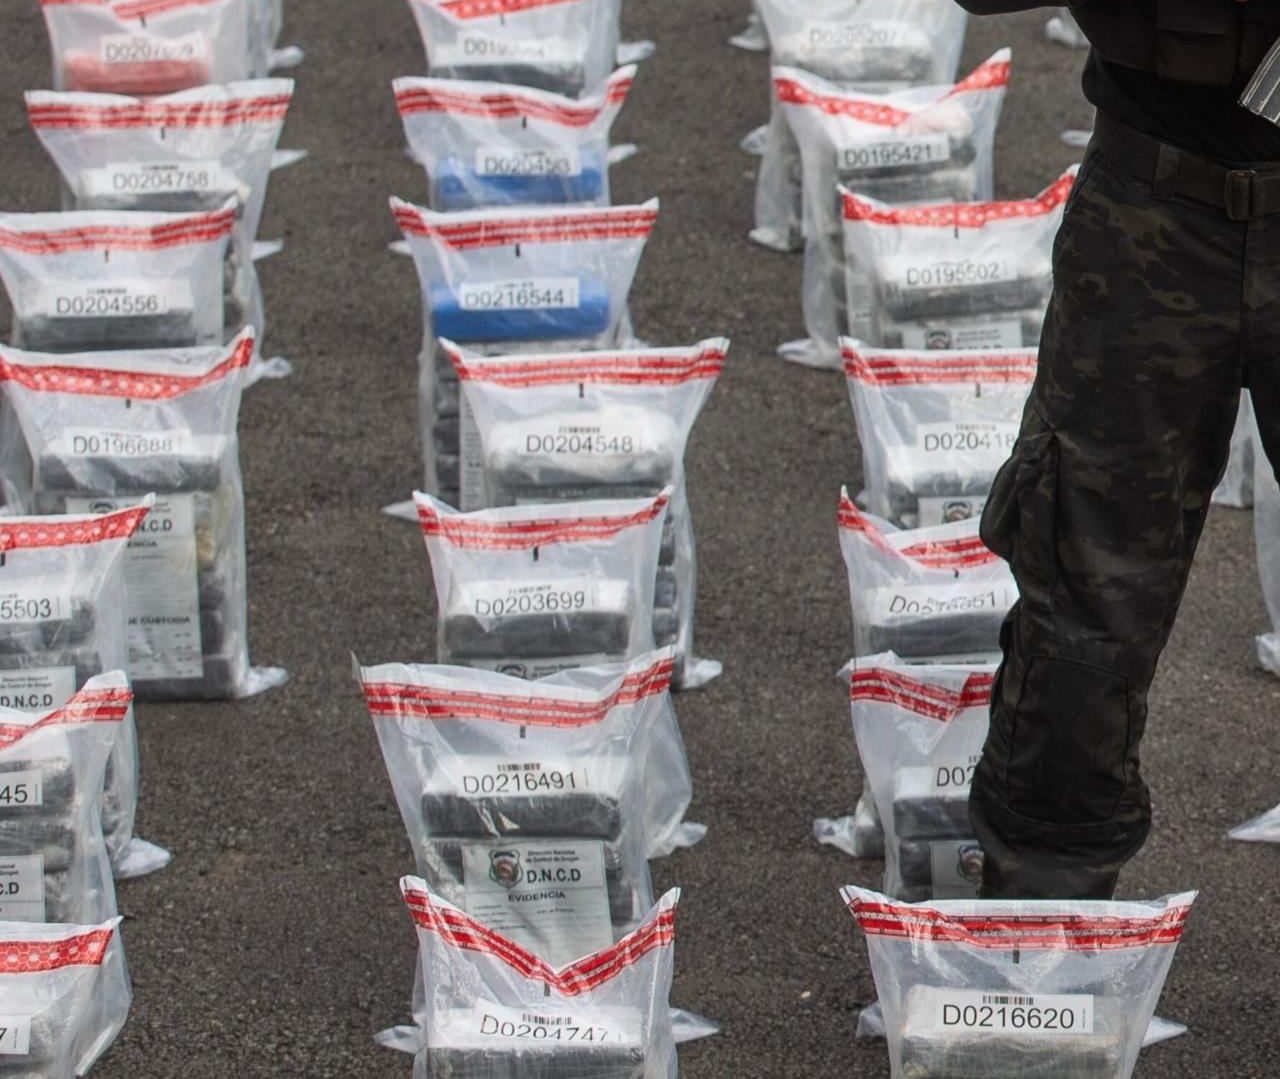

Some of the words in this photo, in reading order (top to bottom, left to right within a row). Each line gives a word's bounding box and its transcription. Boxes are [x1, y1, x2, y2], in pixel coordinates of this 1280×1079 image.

[844, 144, 932, 167] D0195421
[906, 263, 1000, 286] D0195502
[57, 296, 160, 314] D0204556
[465, 289, 564, 309] D0216544
[526, 434, 634, 453] D0204548
[1, 598, 52, 619] 5503
[475, 590, 586, 616] D0203699
[0, 695, 53, 709] D.N.C.D
[463, 770, 577, 795] D0216491
[526, 868, 582, 884] D.N.C.D
[508, 890, 566, 903] EVIDENCIA
[943, 1003, 1076, 1030] D0216620
[479, 1014, 608, 1042] D0204747
